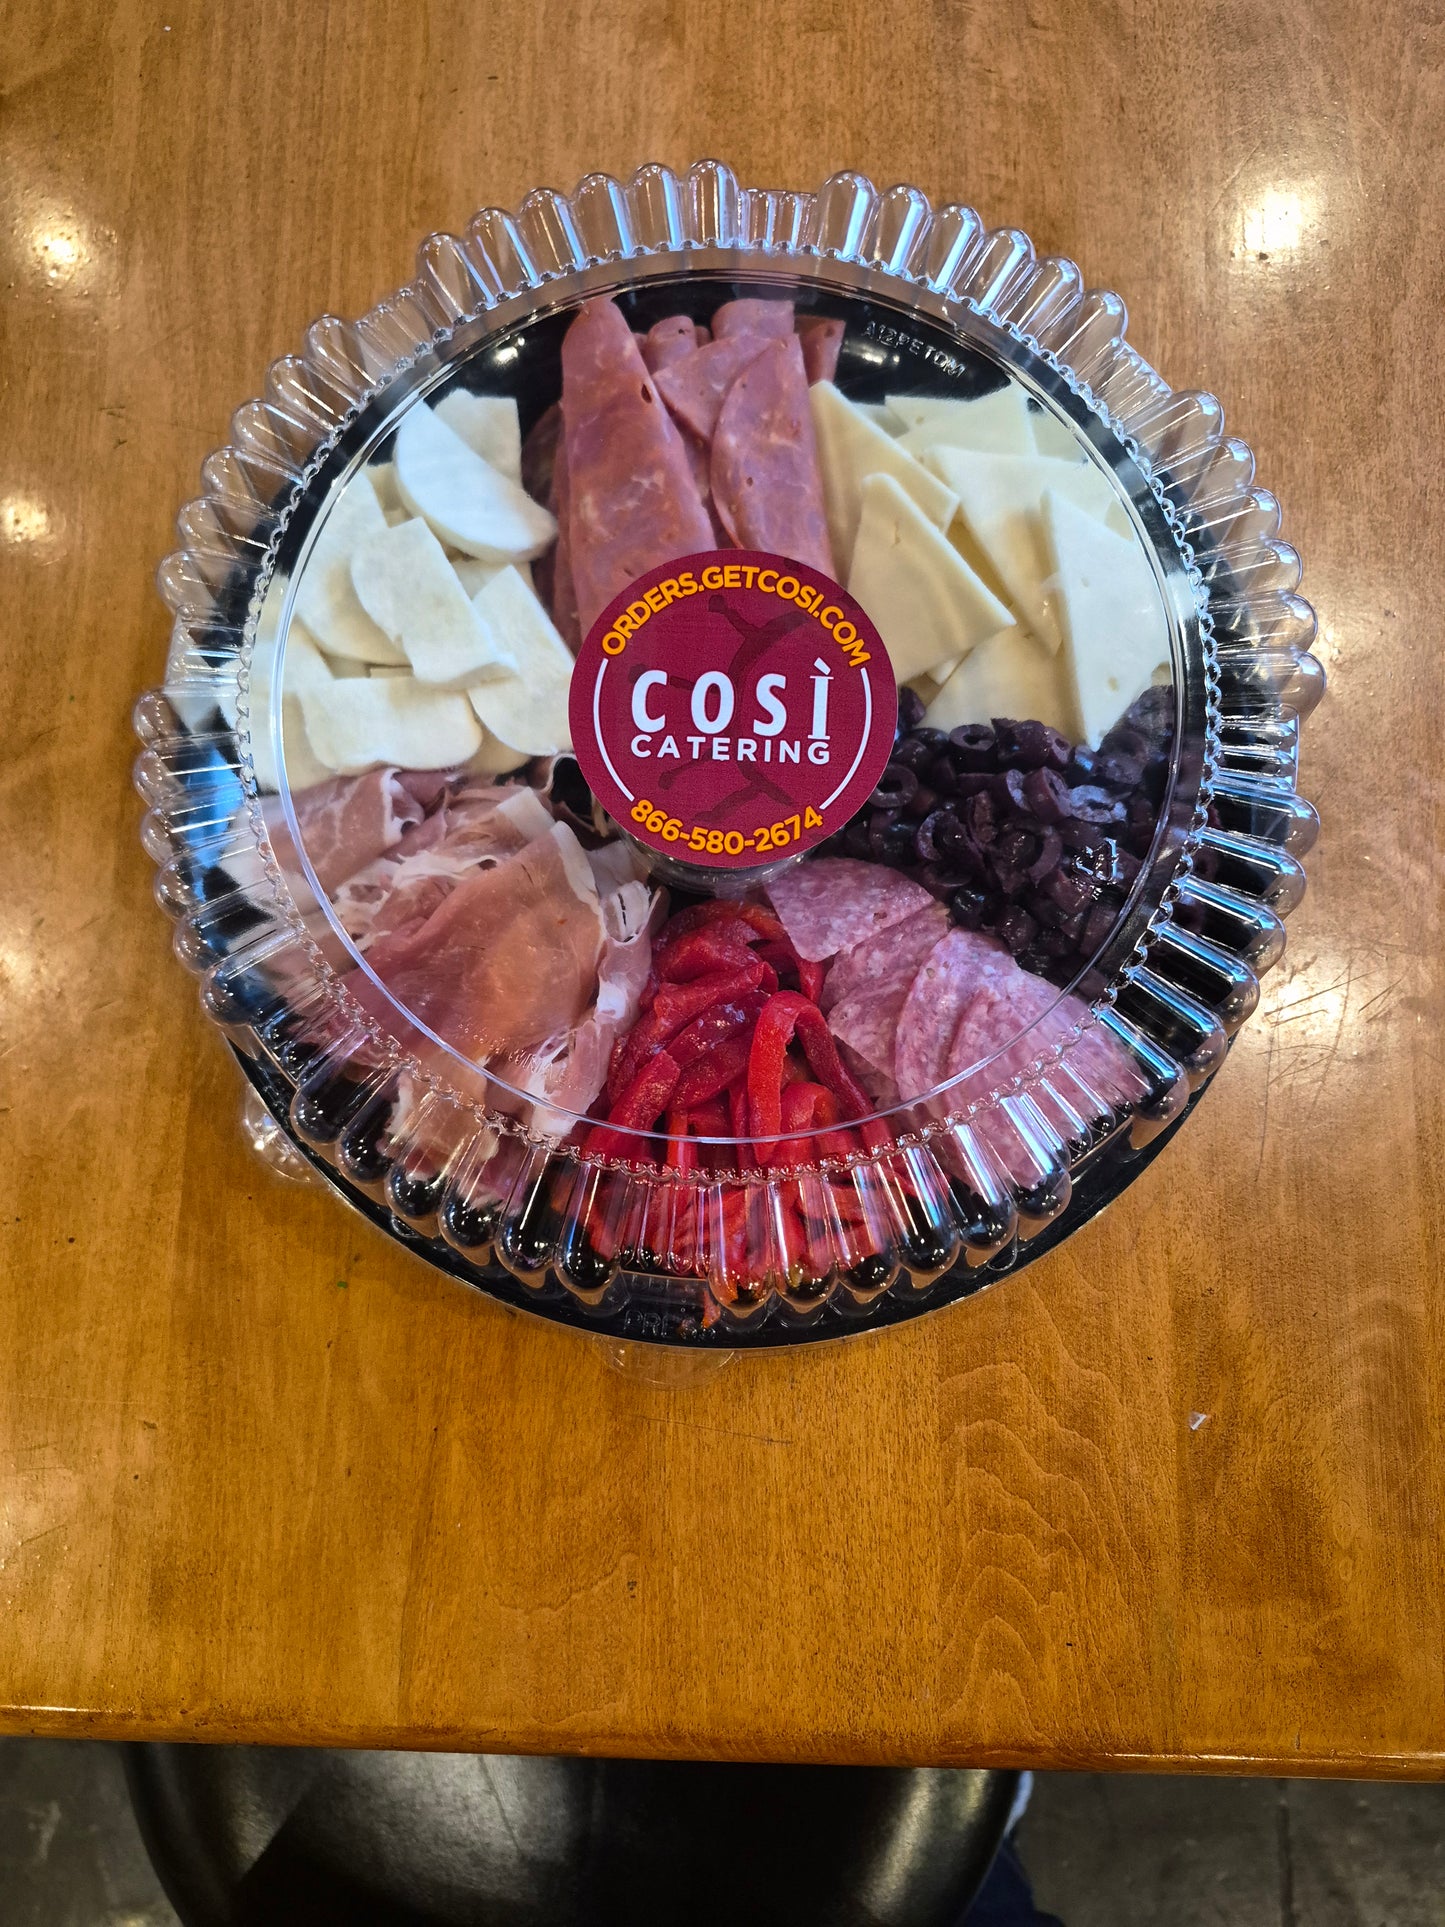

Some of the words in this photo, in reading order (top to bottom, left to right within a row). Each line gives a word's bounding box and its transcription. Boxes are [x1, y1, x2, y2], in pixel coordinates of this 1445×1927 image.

[601, 565, 872, 668] ORDERS.GETCOSI.COM
[631, 657, 834, 740] COSÌ
[630, 734, 831, 765] CATERING
[630, 799, 824, 854] 866-580-2674
